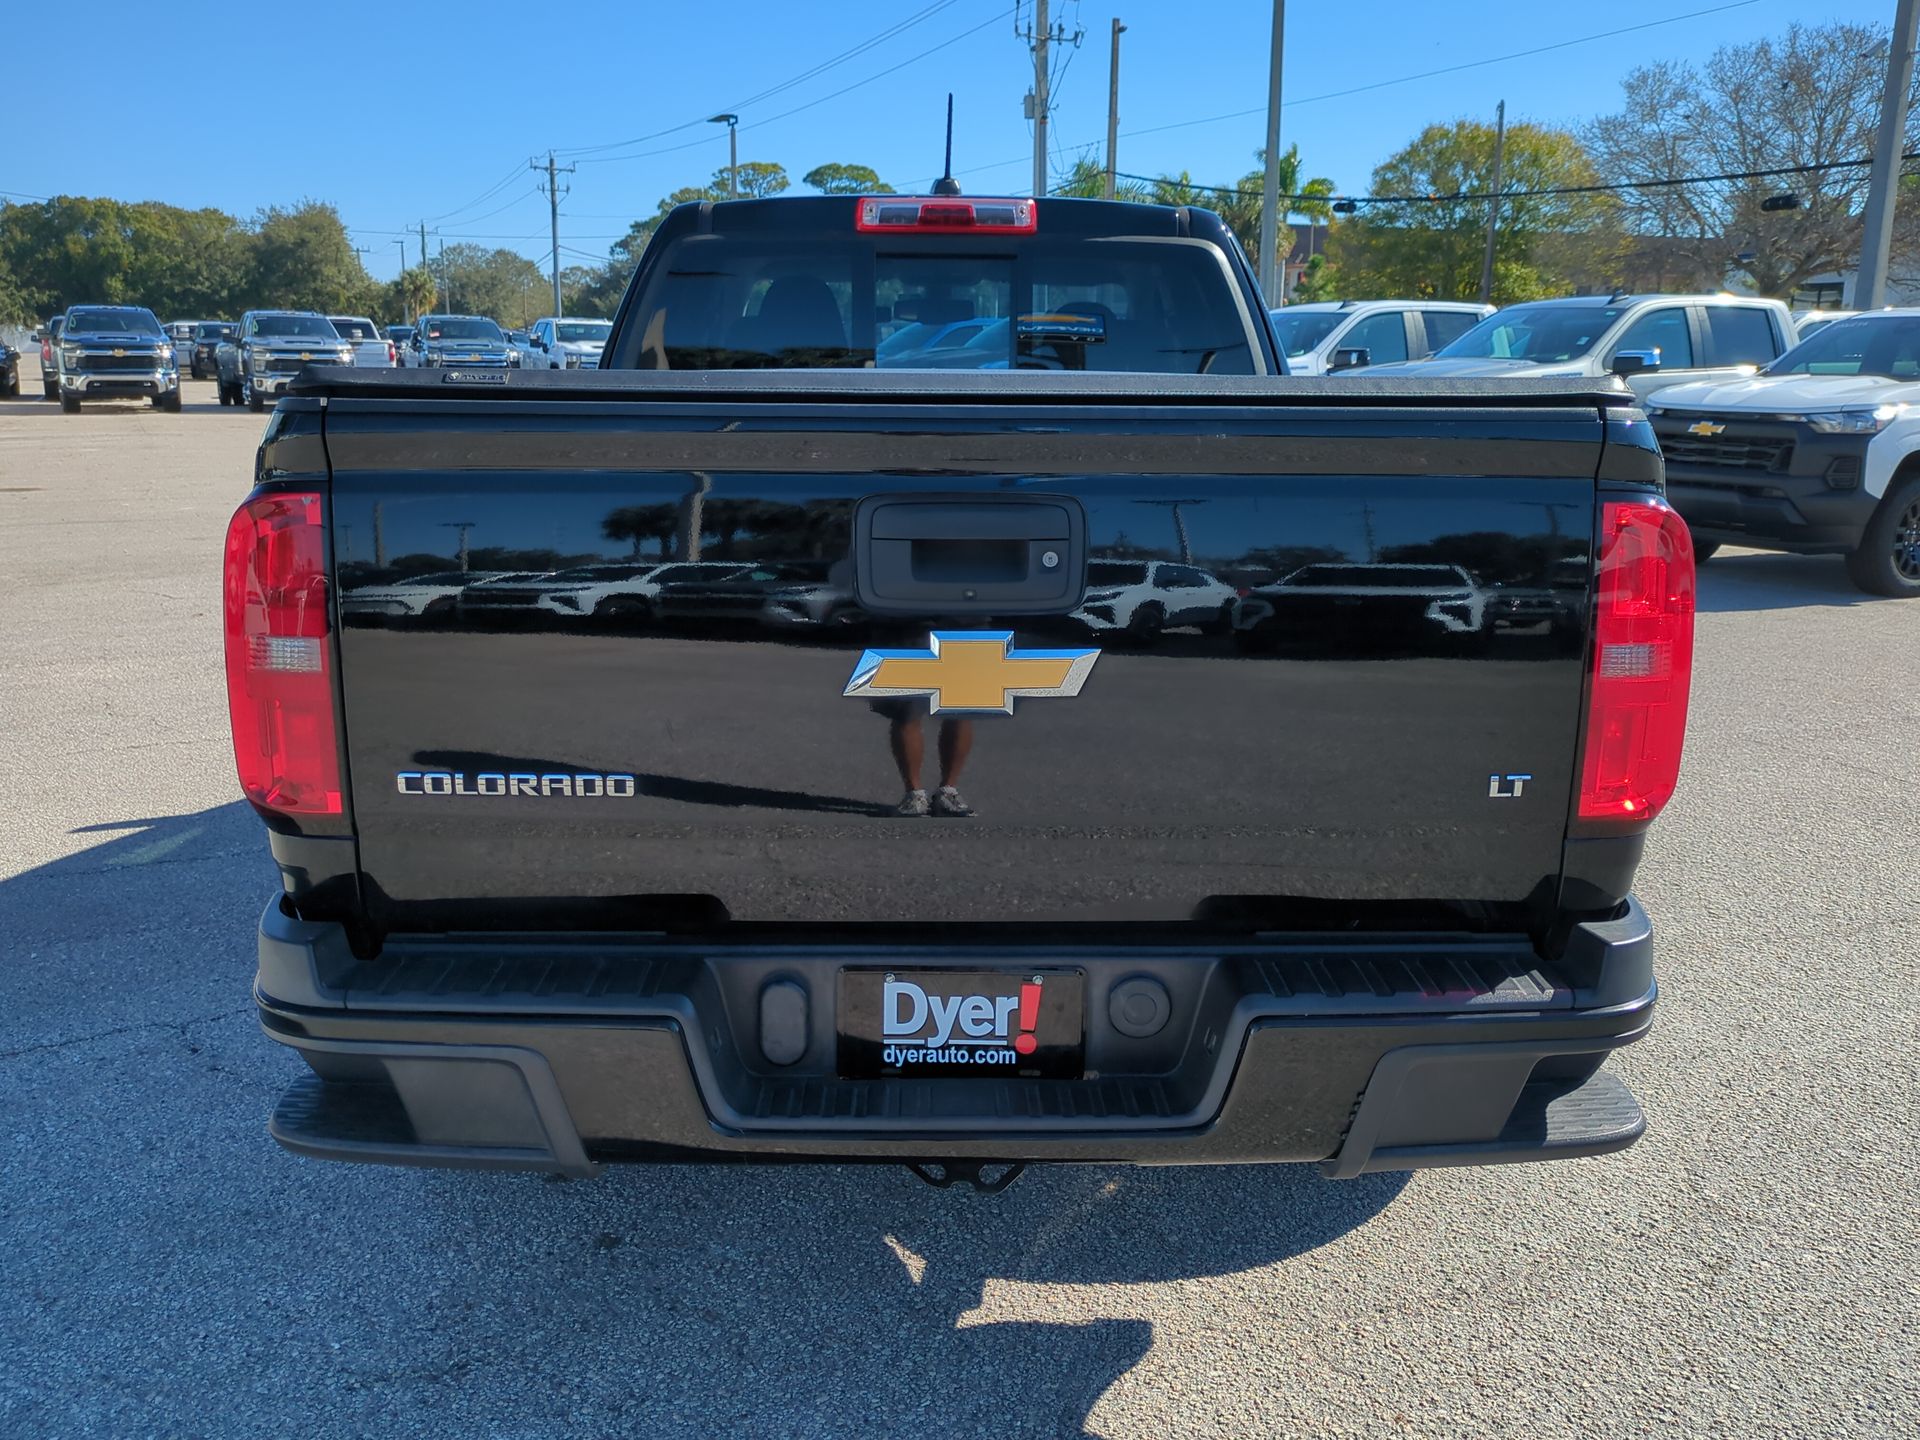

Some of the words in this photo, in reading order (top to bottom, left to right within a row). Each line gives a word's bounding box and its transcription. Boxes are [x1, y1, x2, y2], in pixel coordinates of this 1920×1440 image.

[397, 771, 635, 797] COLORADO
[1489, 774, 1532, 798] LT
[883, 981, 1042, 1055] Dyer!
[883, 1045, 1016, 1067] dyerauto.com
